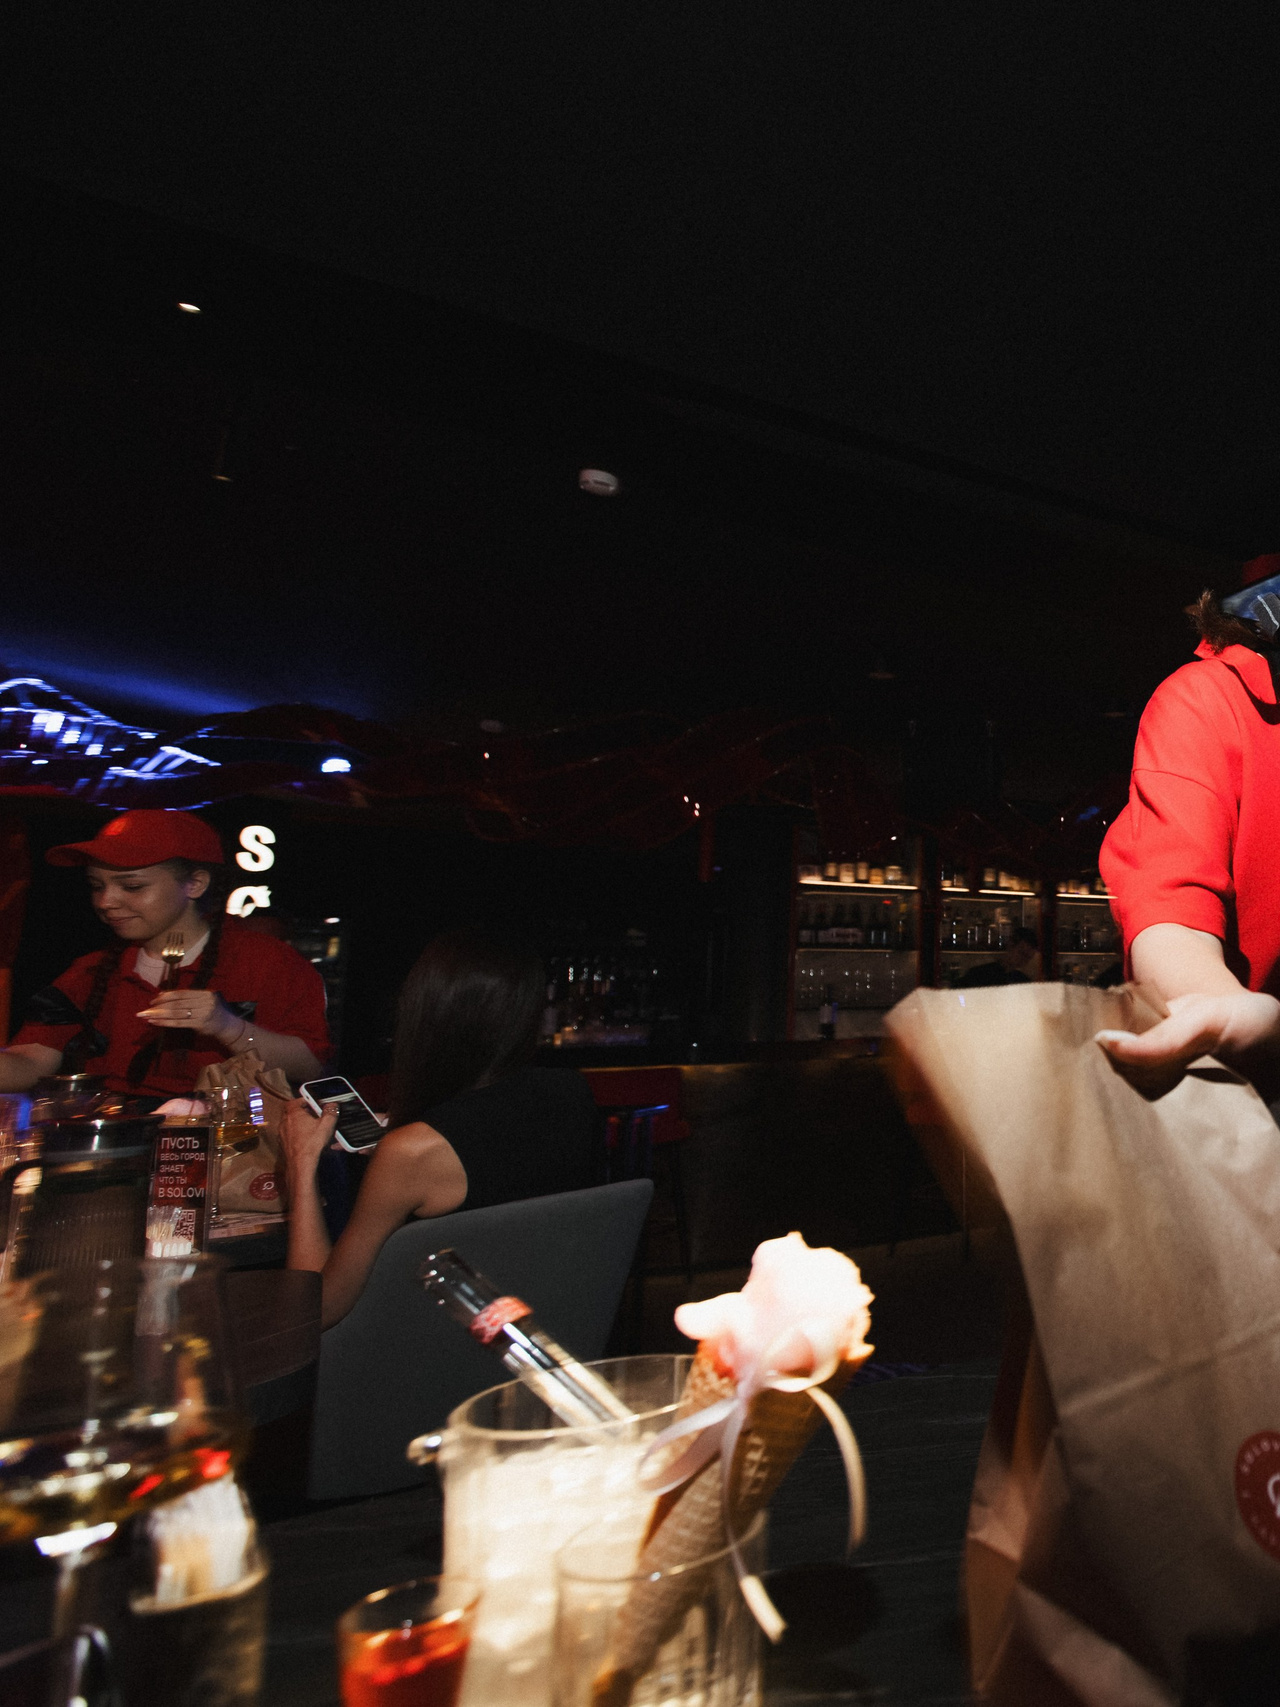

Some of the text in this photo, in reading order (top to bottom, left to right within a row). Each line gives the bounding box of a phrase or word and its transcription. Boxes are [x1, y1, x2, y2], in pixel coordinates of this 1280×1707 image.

[160, 1137, 200, 1149] ПУСТЬ
[160, 1152, 205, 1161] ВЕСЬ ГОРОД
[159, 1164, 187, 1174] ЗНАЕТ,
[175, 1176, 188, 1184] ТЫ
[167, 1187, 205, 1198] SOLOVI
